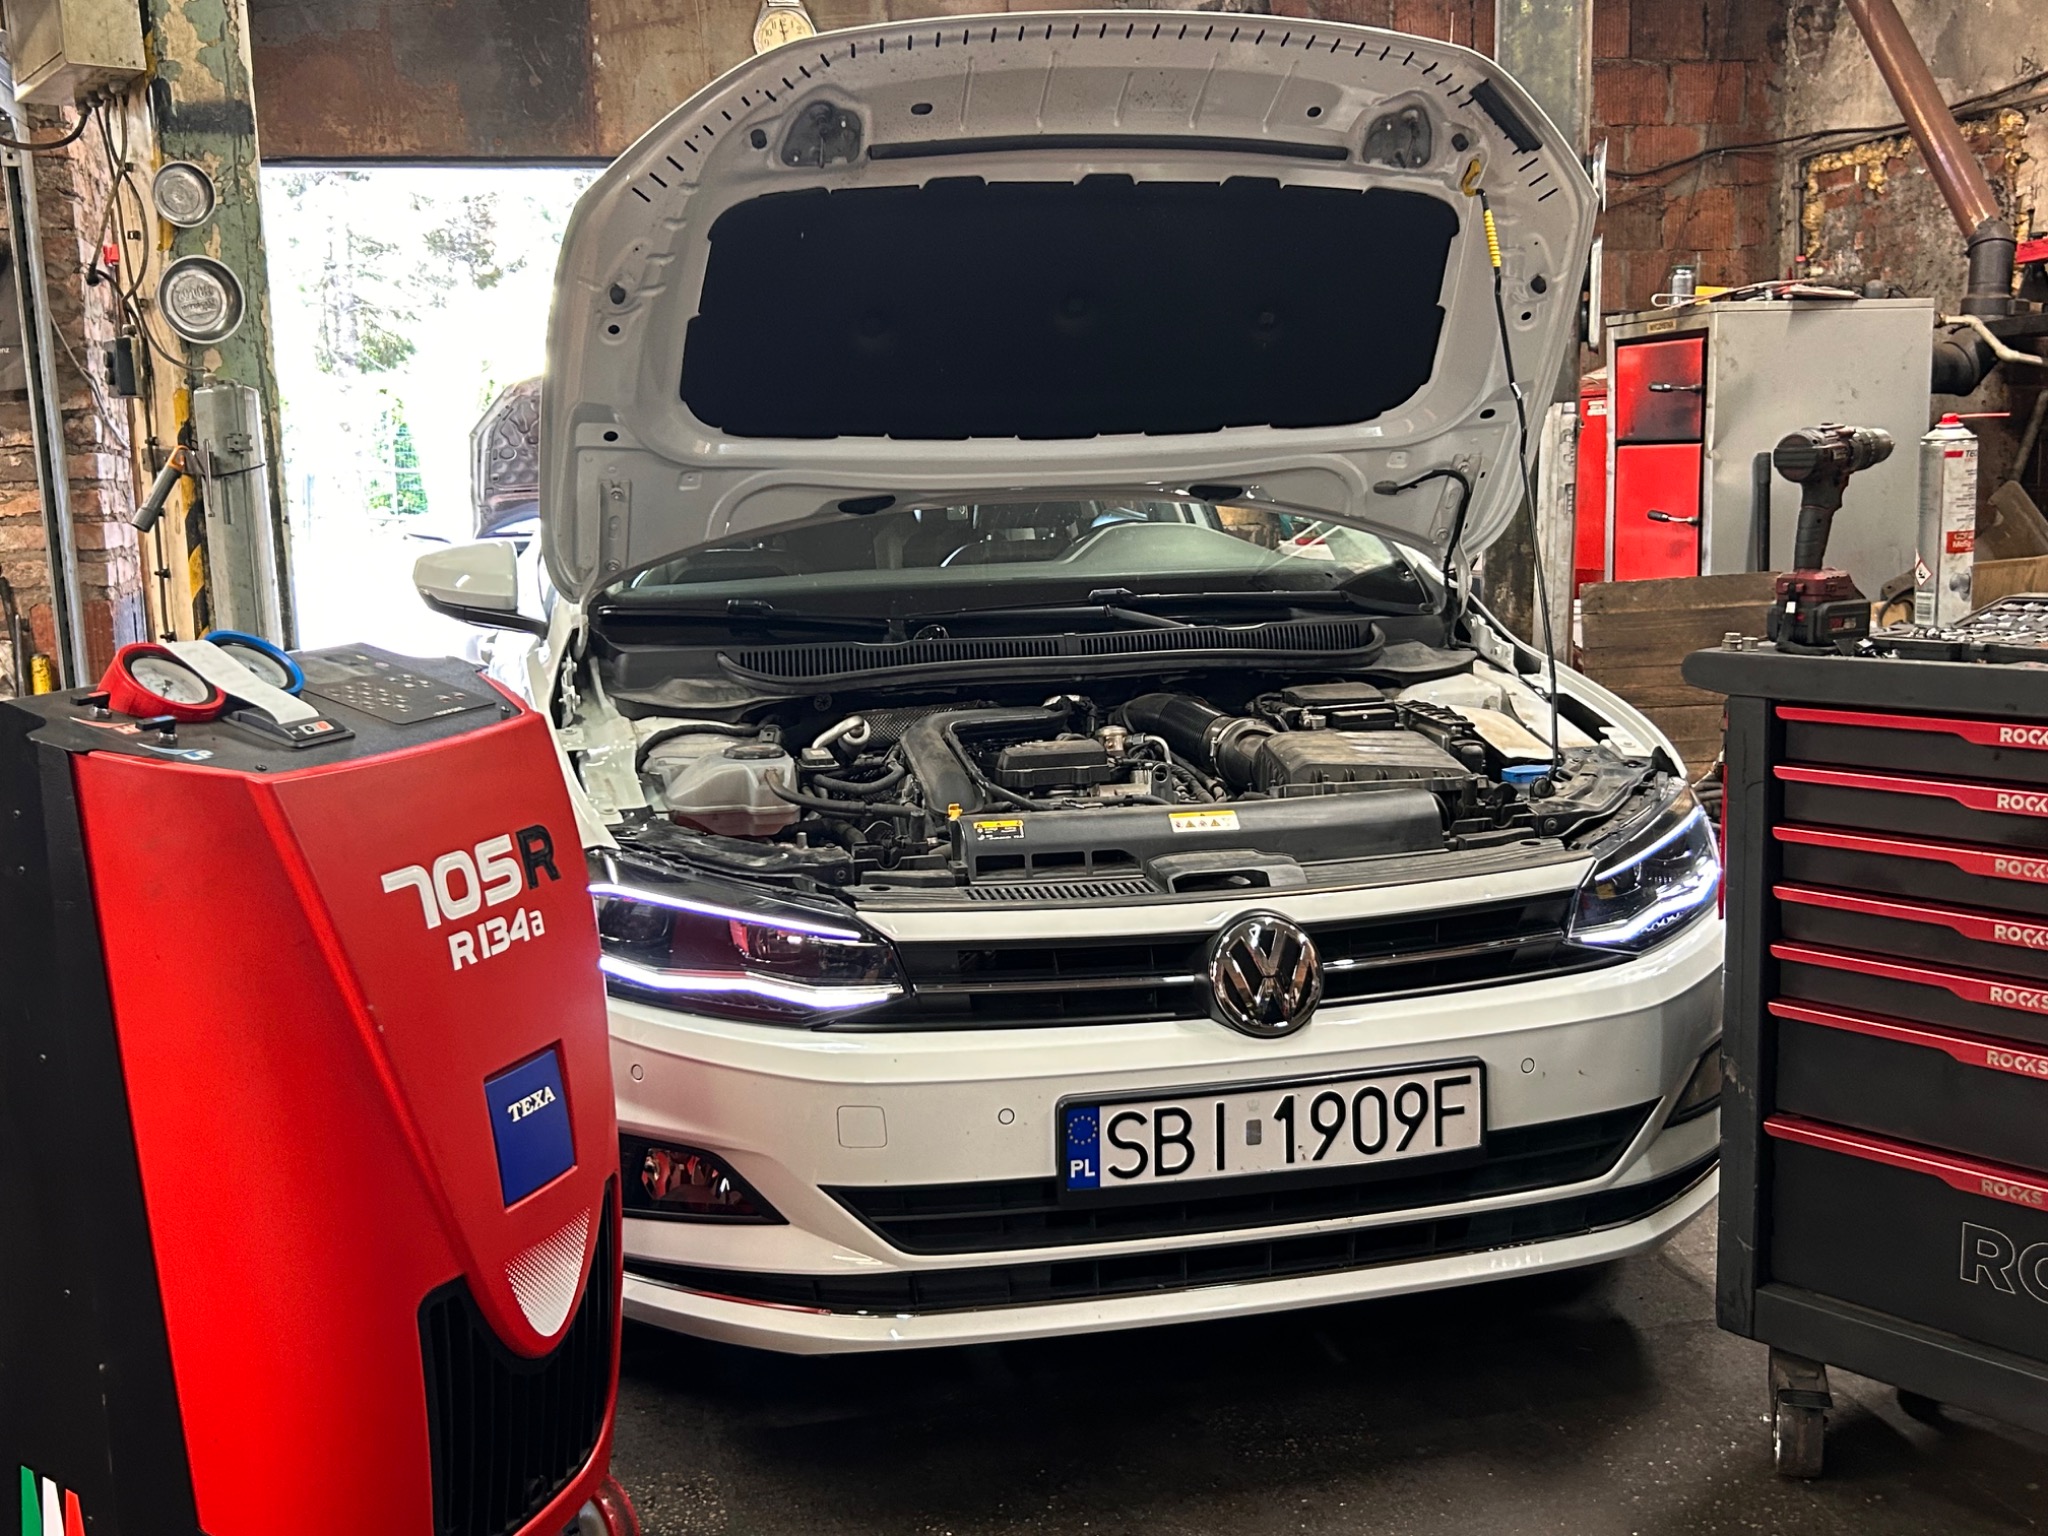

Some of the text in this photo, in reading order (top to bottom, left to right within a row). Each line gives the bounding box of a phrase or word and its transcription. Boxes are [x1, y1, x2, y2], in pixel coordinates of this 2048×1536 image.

[380, 824, 562, 930] 705R
[1994, 858, 2048, 880] ROCK
[1993, 924, 2048, 946] ROCK
[1986, 1050, 2048, 1075] ROCKS
[507, 1085, 556, 1122] TEXA
[1107, 1074, 1472, 1179] SBI 1909F
[1070, 1158, 1096, 1179] PL
[1981, 1179, 2043, 1205] ROCKS
